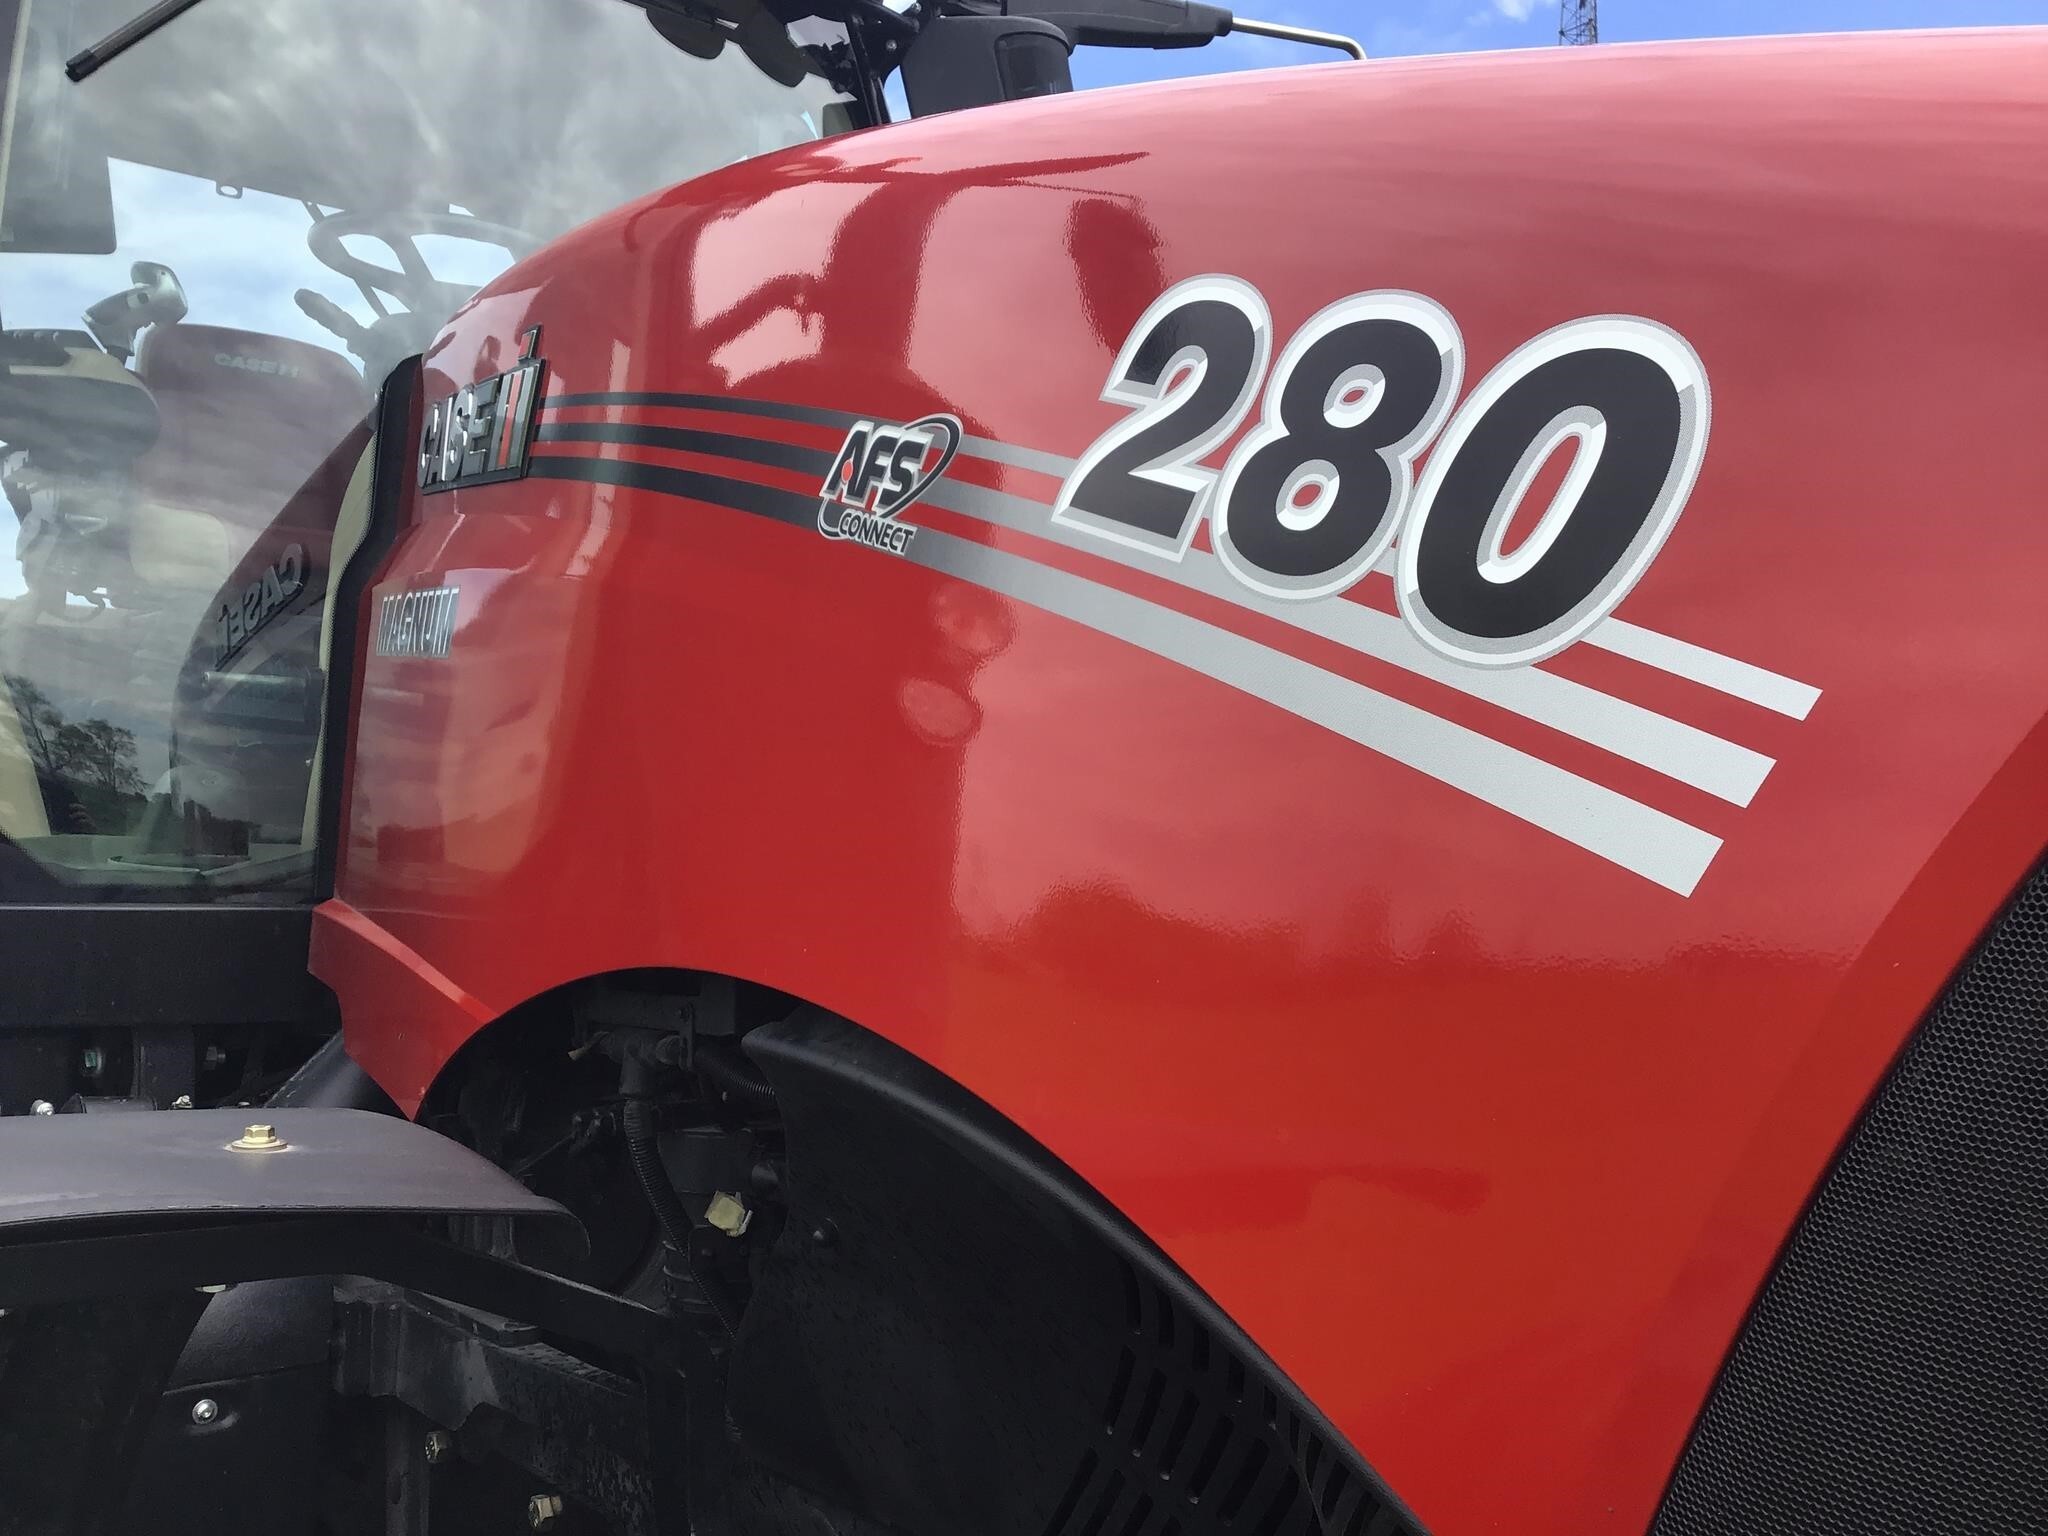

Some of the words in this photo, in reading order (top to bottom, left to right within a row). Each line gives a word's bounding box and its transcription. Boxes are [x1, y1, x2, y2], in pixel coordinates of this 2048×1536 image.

[418, 380, 500, 488] CASE
[820, 421, 934, 511] AFS
[1052, 273, 1712, 670] 280
[838, 509, 918, 556] CONNECT
[376, 588, 459, 656] MAGNUM
